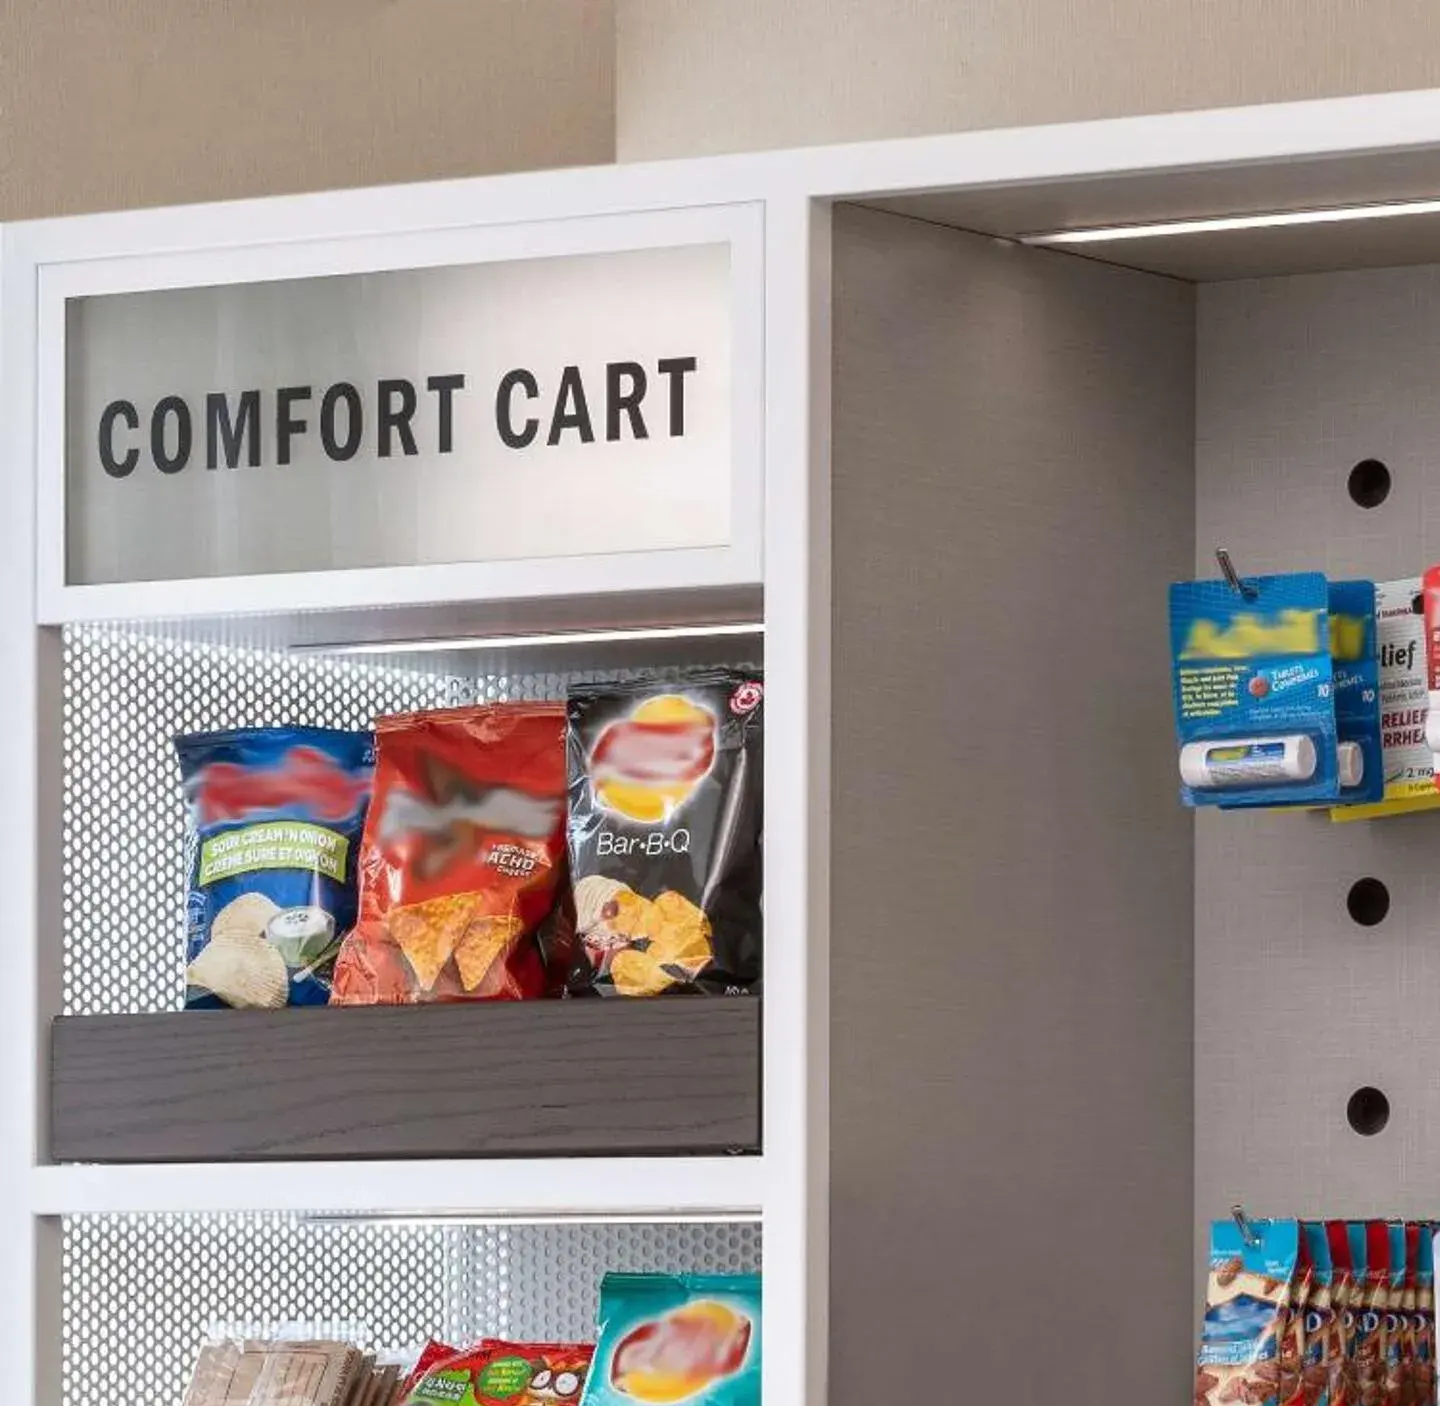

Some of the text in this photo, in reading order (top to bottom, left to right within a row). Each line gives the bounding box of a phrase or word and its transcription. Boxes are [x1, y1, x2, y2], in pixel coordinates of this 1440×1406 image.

[99, 356, 697, 478] COMFORT CART
[1381, 640, 1416, 670] lief
[488, 850, 535, 870] ACHO
